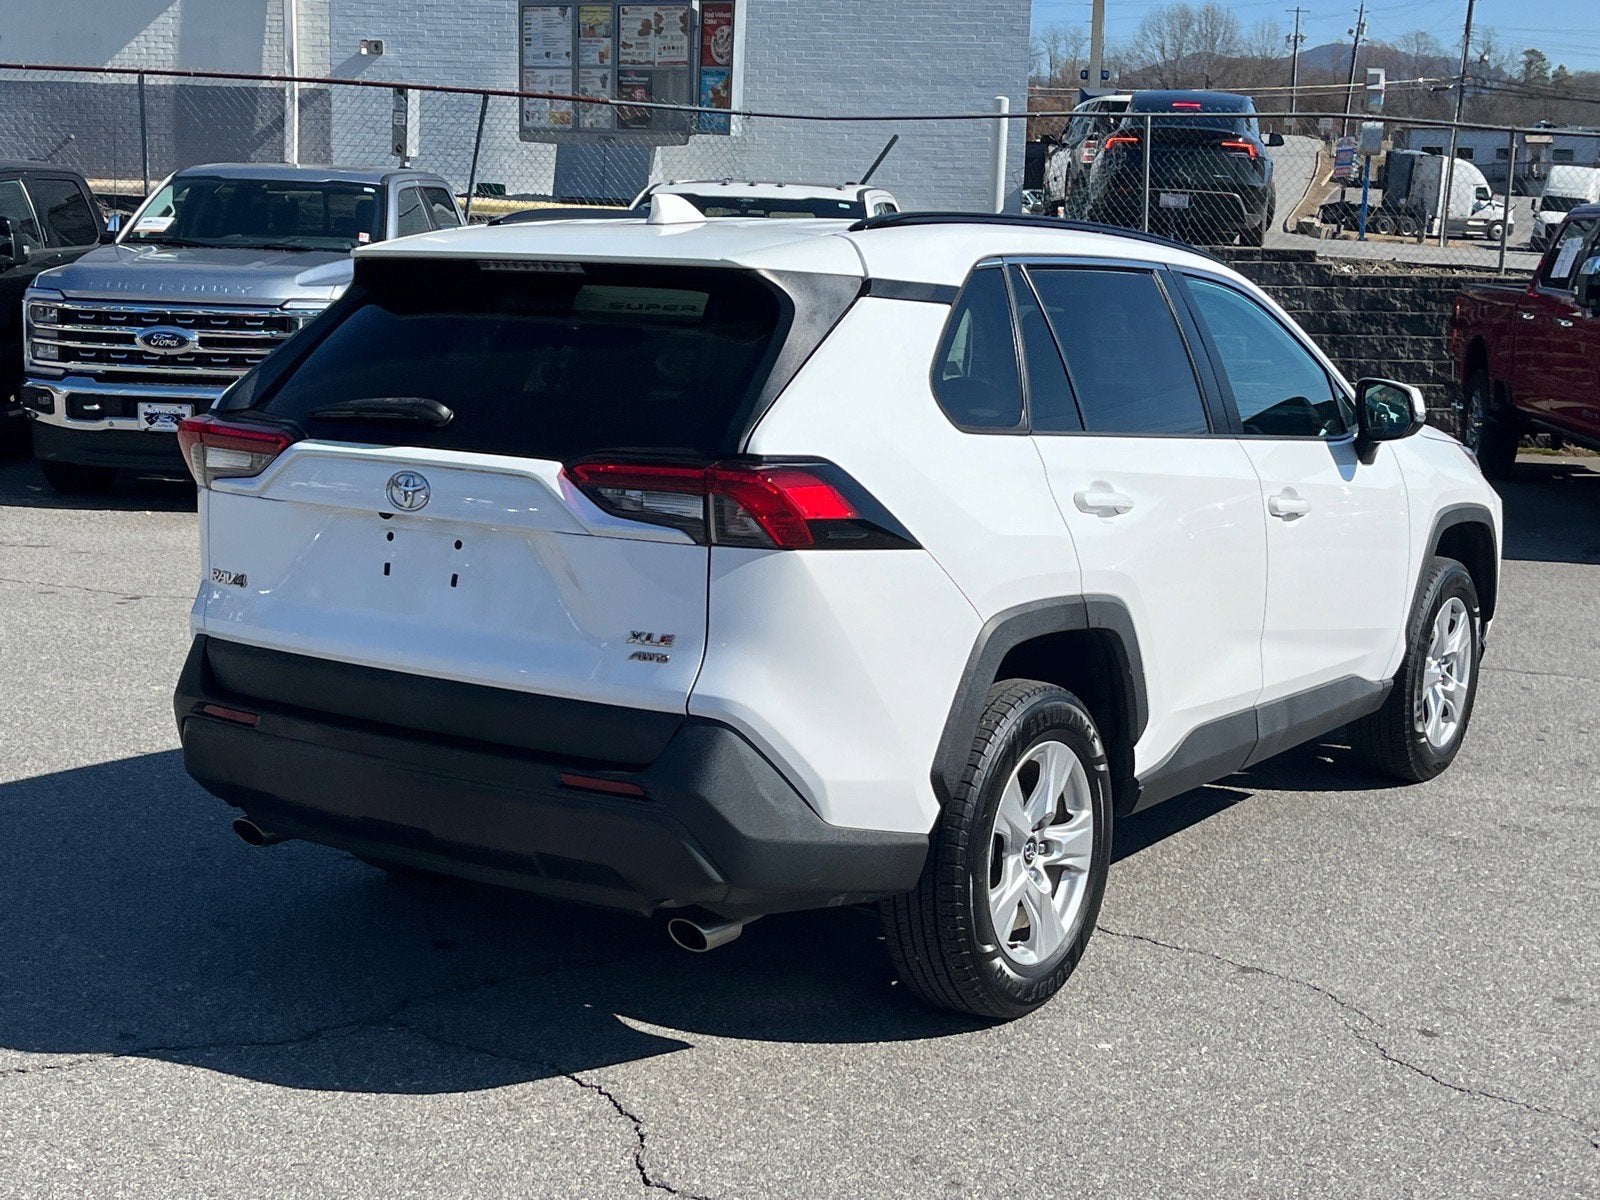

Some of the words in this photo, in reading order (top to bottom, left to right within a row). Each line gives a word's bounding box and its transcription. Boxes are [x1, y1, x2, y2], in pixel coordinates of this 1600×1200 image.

[607, 302, 698, 312] SUPER
[150, 333, 179, 348] Ford
[212, 567, 248, 588] RAV4
[626, 630, 676, 647] XLE
[627, 651, 670, 664] AWD
